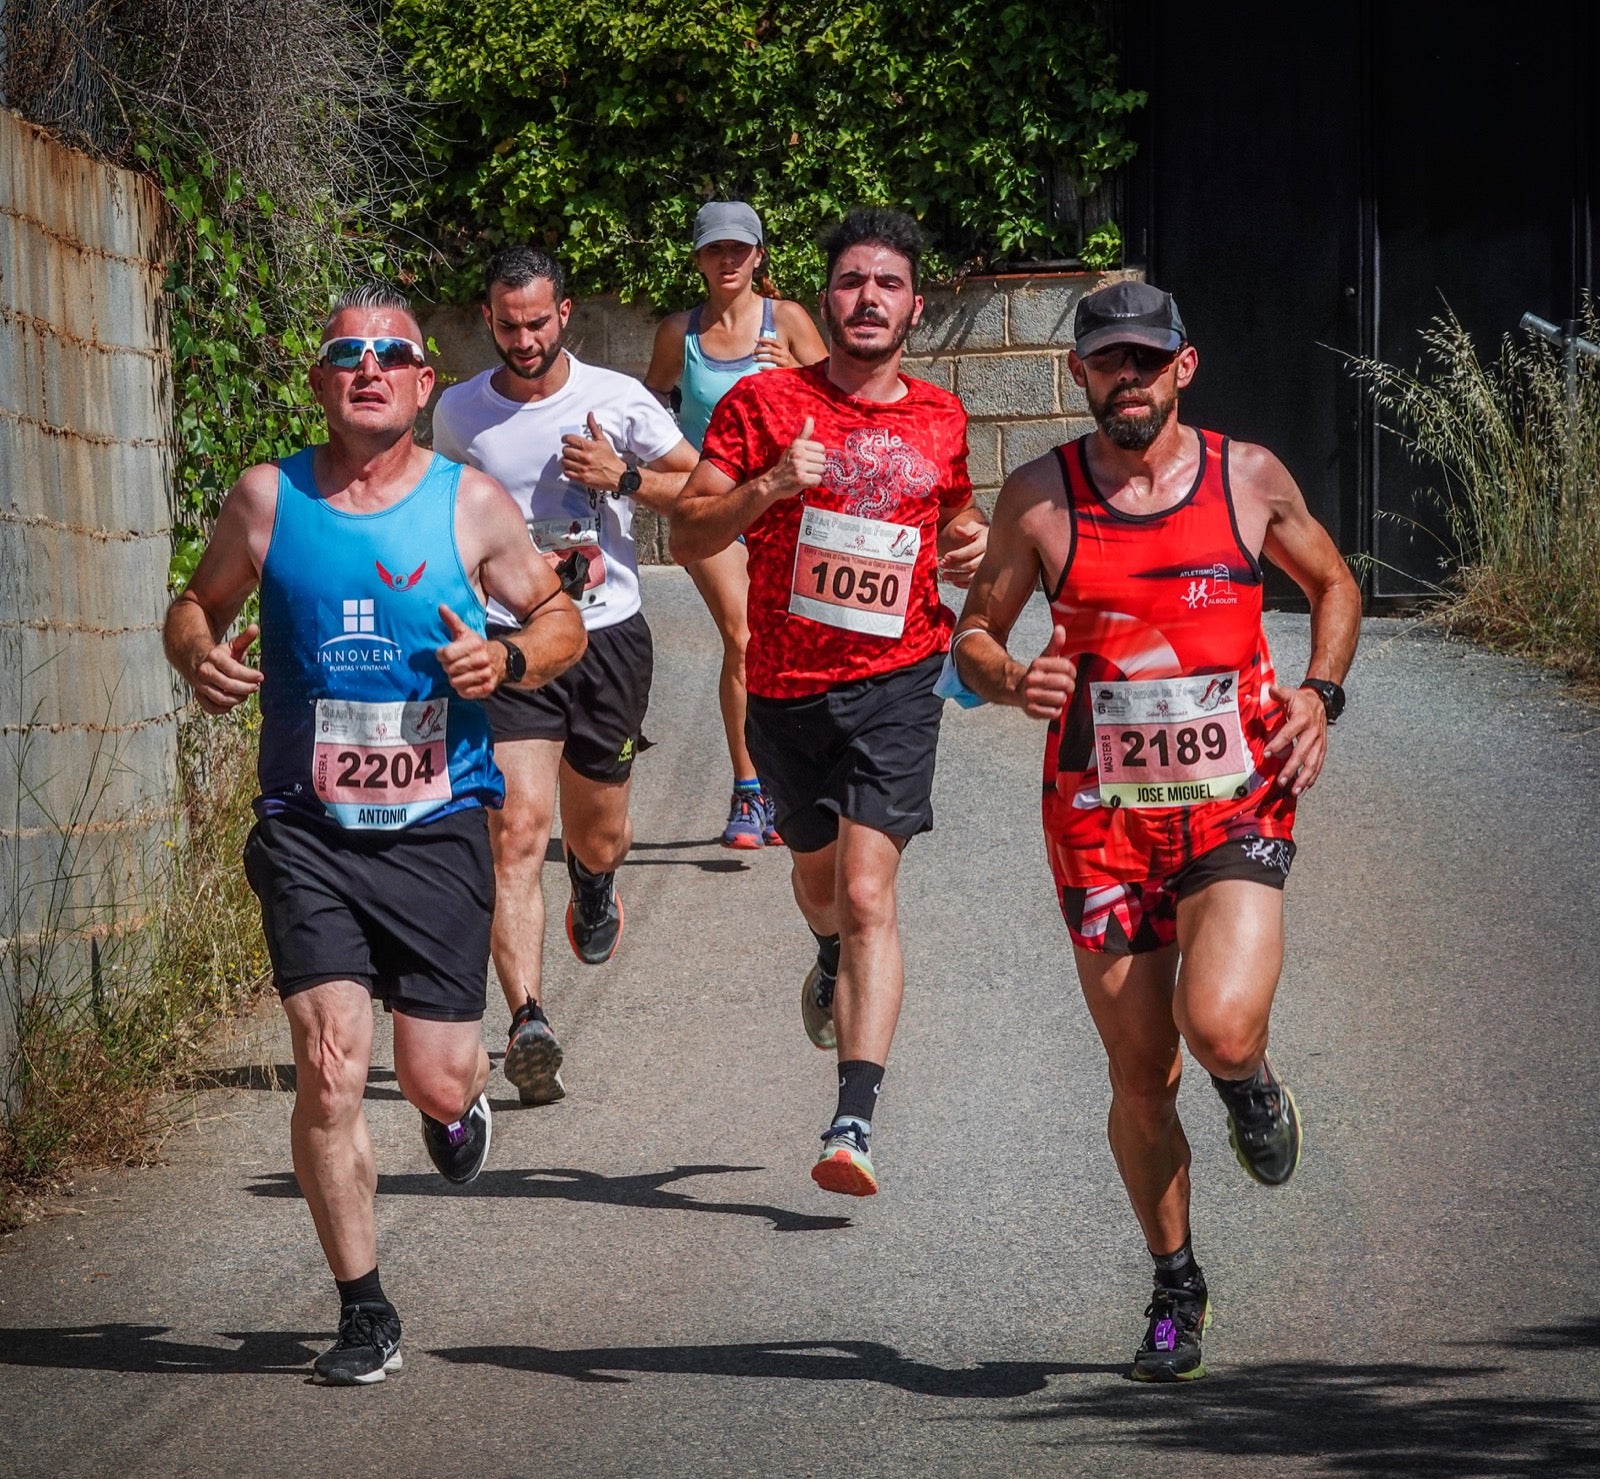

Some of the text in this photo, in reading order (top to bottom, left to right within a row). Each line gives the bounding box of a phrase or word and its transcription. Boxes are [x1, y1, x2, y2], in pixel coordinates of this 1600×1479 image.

[861, 429, 902, 448] vale
[1180, 568, 1214, 577] ATLETISMO
[812, 561, 899, 607] 1050
[317, 649, 402, 664] INNOVENT
[329, 664, 355, 672] PUERTAS
[1120, 722, 1227, 767] 2189
[1102, 742, 1114, 773] MASTER
[335, 748, 435, 789] 2204
[1136, 784, 1214, 803] JOSE MIGUEL
[358, 808, 407, 825] ANTONIO
